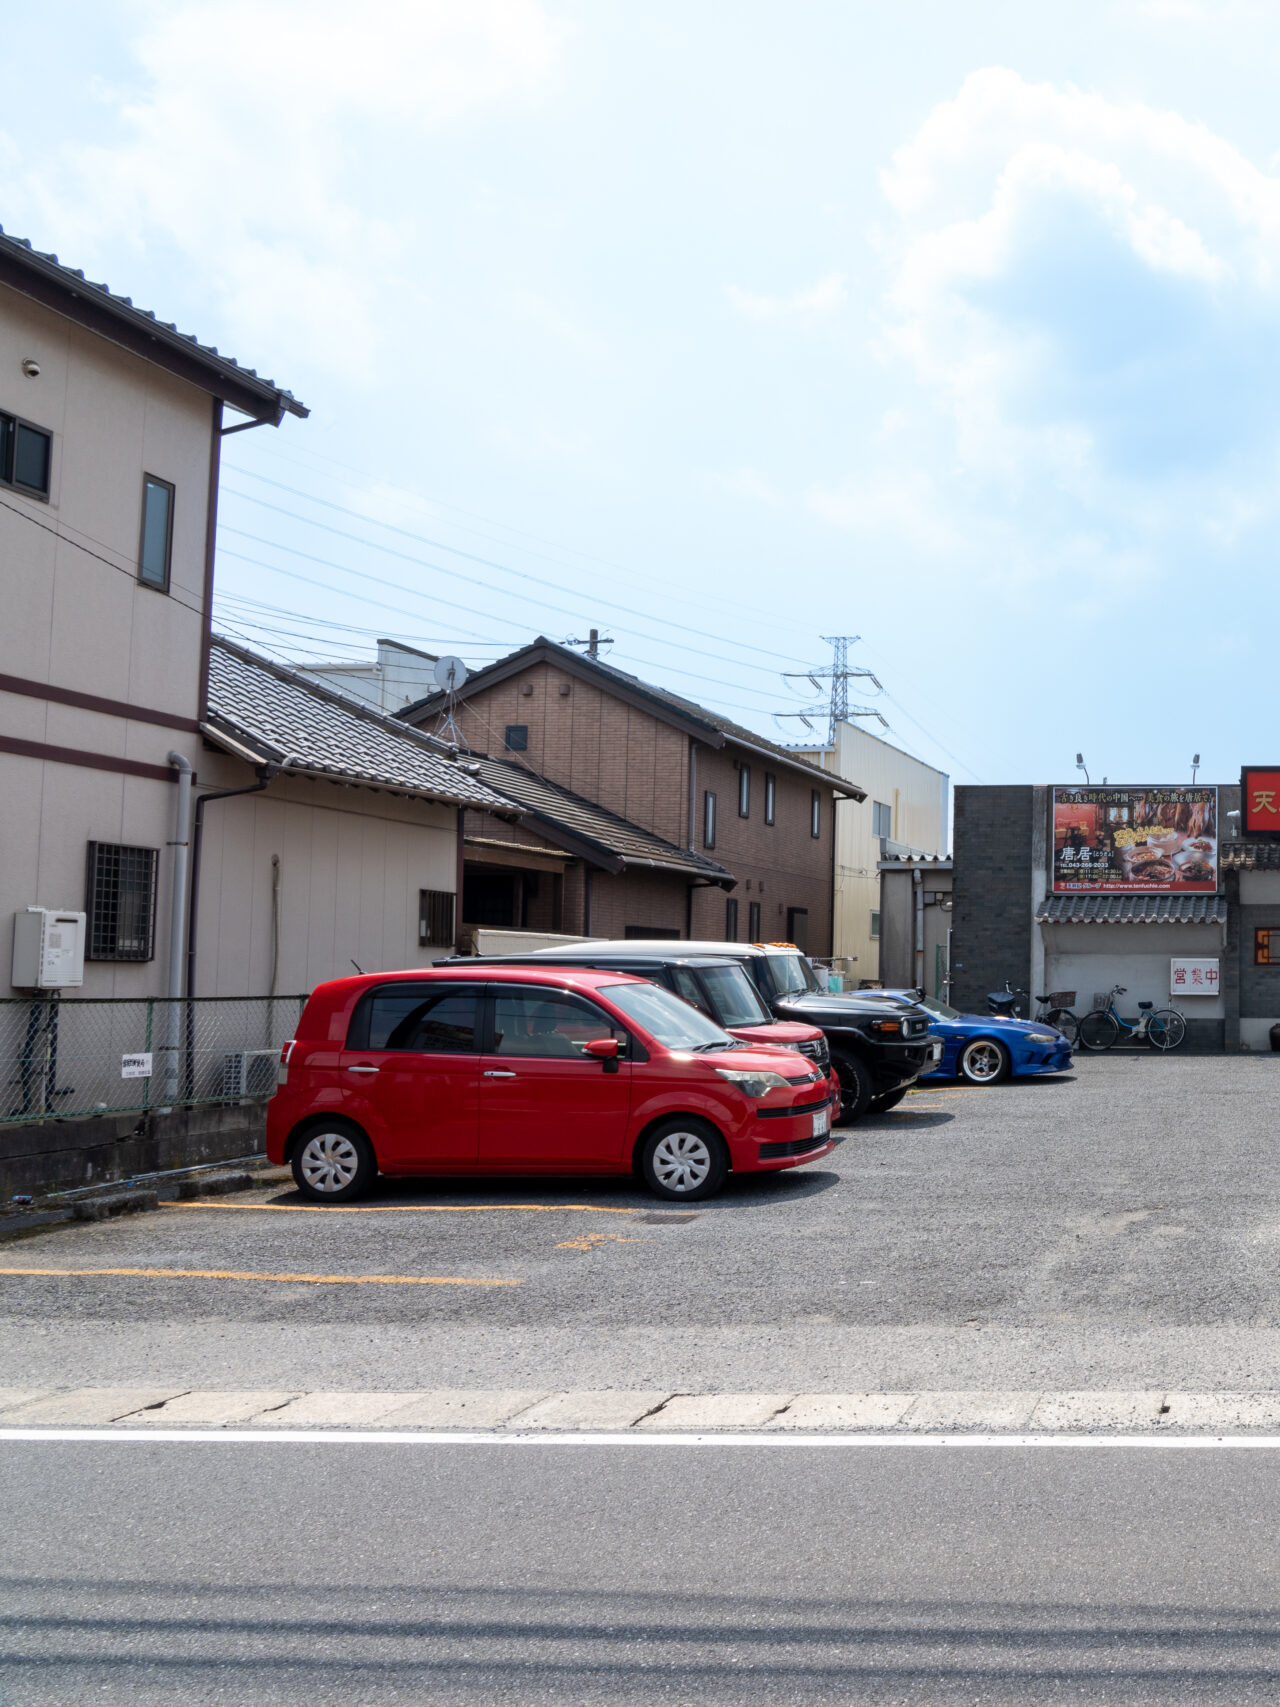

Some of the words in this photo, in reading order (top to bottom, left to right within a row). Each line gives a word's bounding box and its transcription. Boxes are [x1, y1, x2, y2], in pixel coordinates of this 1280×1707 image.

[1060, 846, 1092, 860] 唐居
[1175, 968, 1218, 985] 営業中
